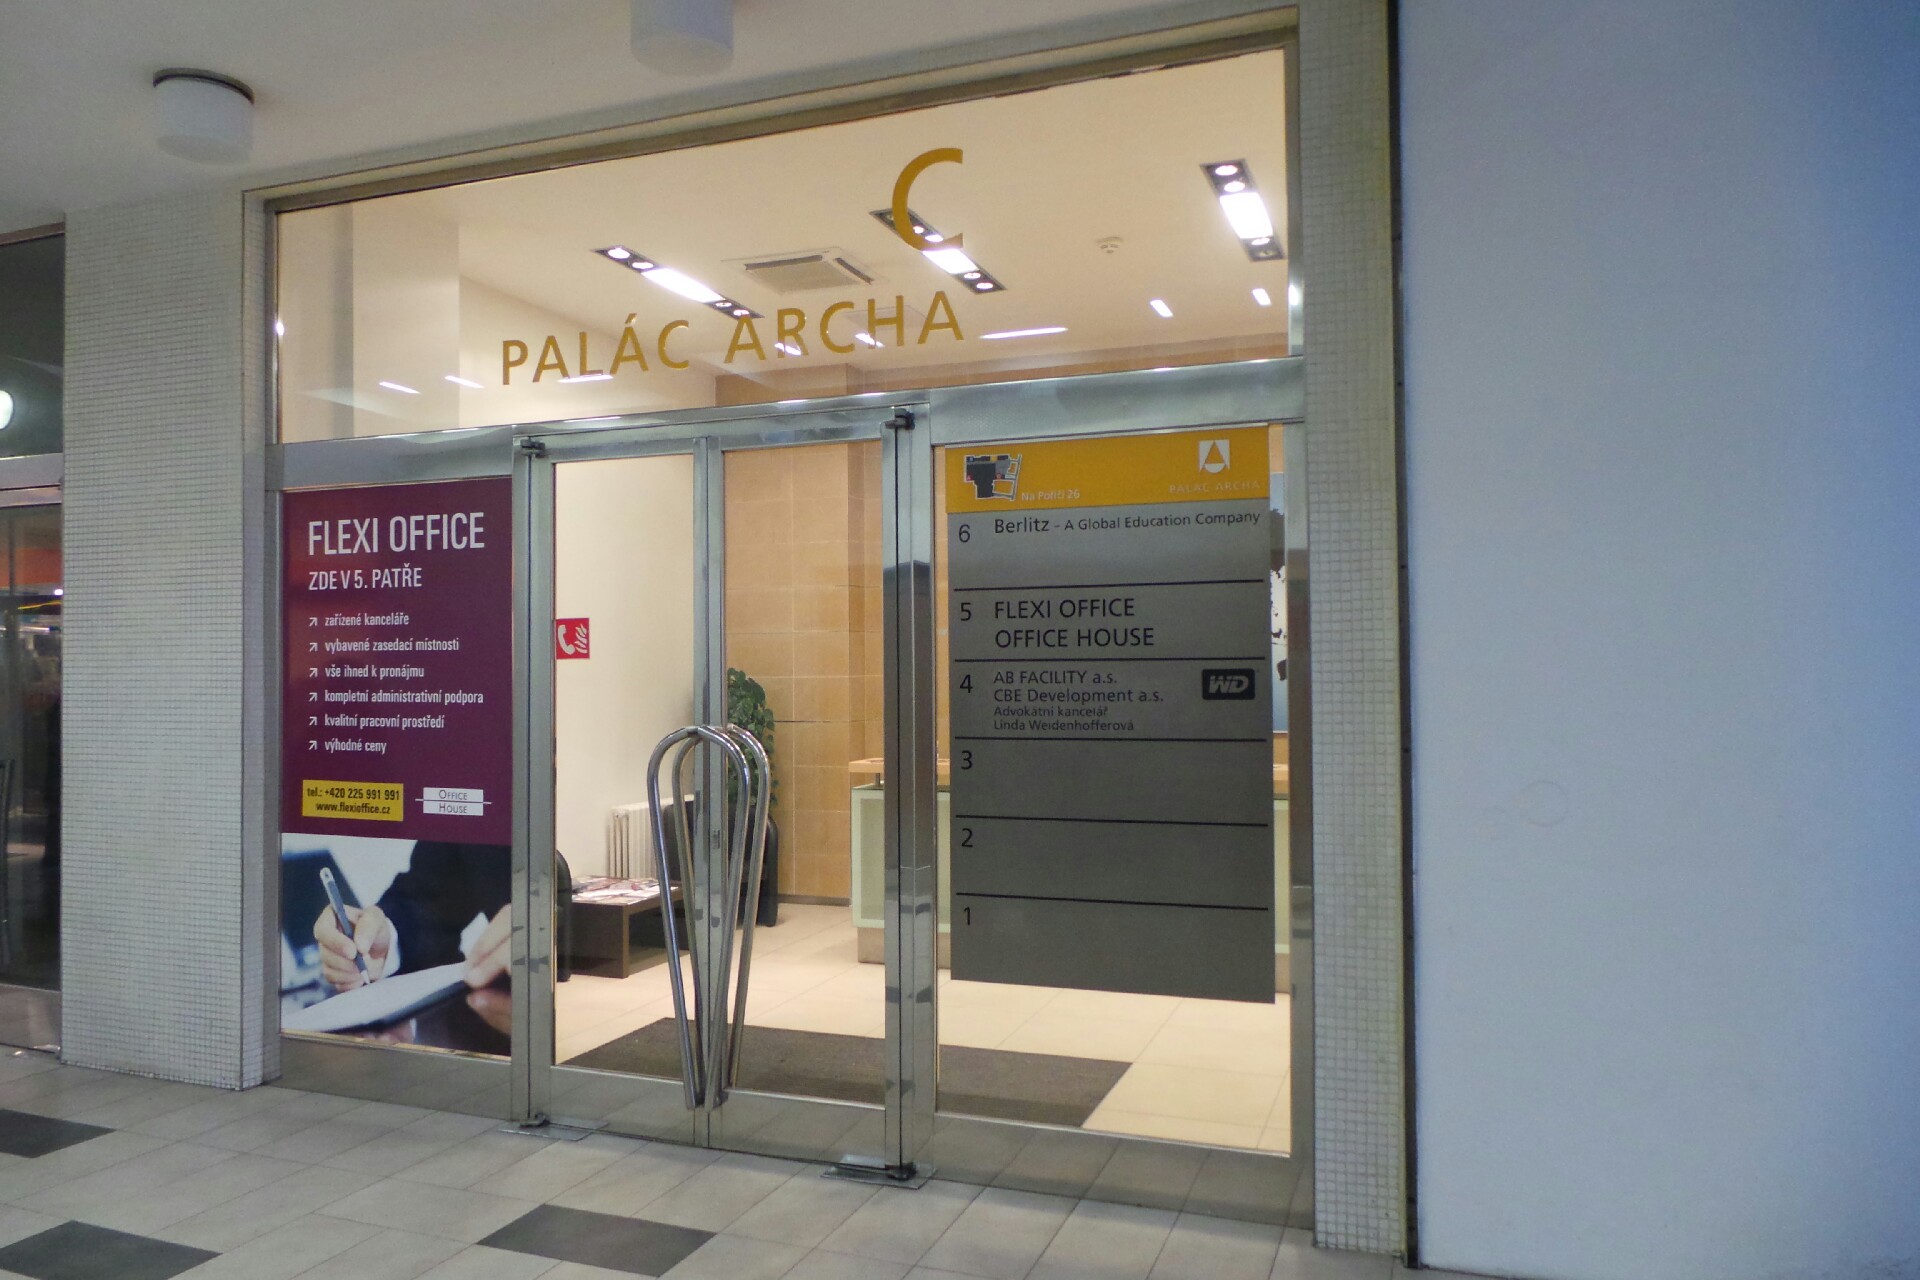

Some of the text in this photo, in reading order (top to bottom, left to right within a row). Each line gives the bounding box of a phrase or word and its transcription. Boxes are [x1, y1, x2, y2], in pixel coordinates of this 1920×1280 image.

[892, 147, 963, 250] C
[502, 290, 965, 386] PALÁC ARCHA
[1067, 489, 1081, 499] 26
[308, 511, 485, 556] FLEXI OFFICE
[958, 523, 971, 543] 6
[994, 517, 1050, 535] Berlitz
[1064, 519, 1075, 532] A
[1077, 516, 1121, 531] Global
[1124, 513, 1191, 529] Education
[1195, 511, 1261, 527] Company
[308, 562, 423, 591] ZDE V 5. PATŘE
[324, 611, 410, 627] zařízené kanceláře
[959, 598, 1136, 621] 5 FLEXI OFFICE
[324, 637, 459, 655] vybavené zasedací místnosti
[994, 627, 1155, 650] OFFICE HOUSE
[324, 664, 425, 681] vše ihned k pronájmu
[993, 670, 1118, 685] AB FACILITY a.s.
[959, 674, 974, 694] 4
[1208, 674, 1249, 694] WD
[324, 689, 485, 706] kompletní administrativní podpora
[993, 688, 1164, 706] CBE Development a.s.
[324, 713, 446, 730] kvalitní pracovní prostředí
[993, 719, 1026, 731] Linda
[324, 737, 387, 755] výhodné ceny
[960, 750, 973, 770] 3
[324, 787, 346, 799] +420
[347, 788, 364, 800] 225
[366, 789, 382, 801] 991
[384, 789, 401, 802] 991
[315, 802, 391, 815] www.flexioffice.cz
[961, 828, 974, 848] 2
[963, 906, 971, 926] 1
